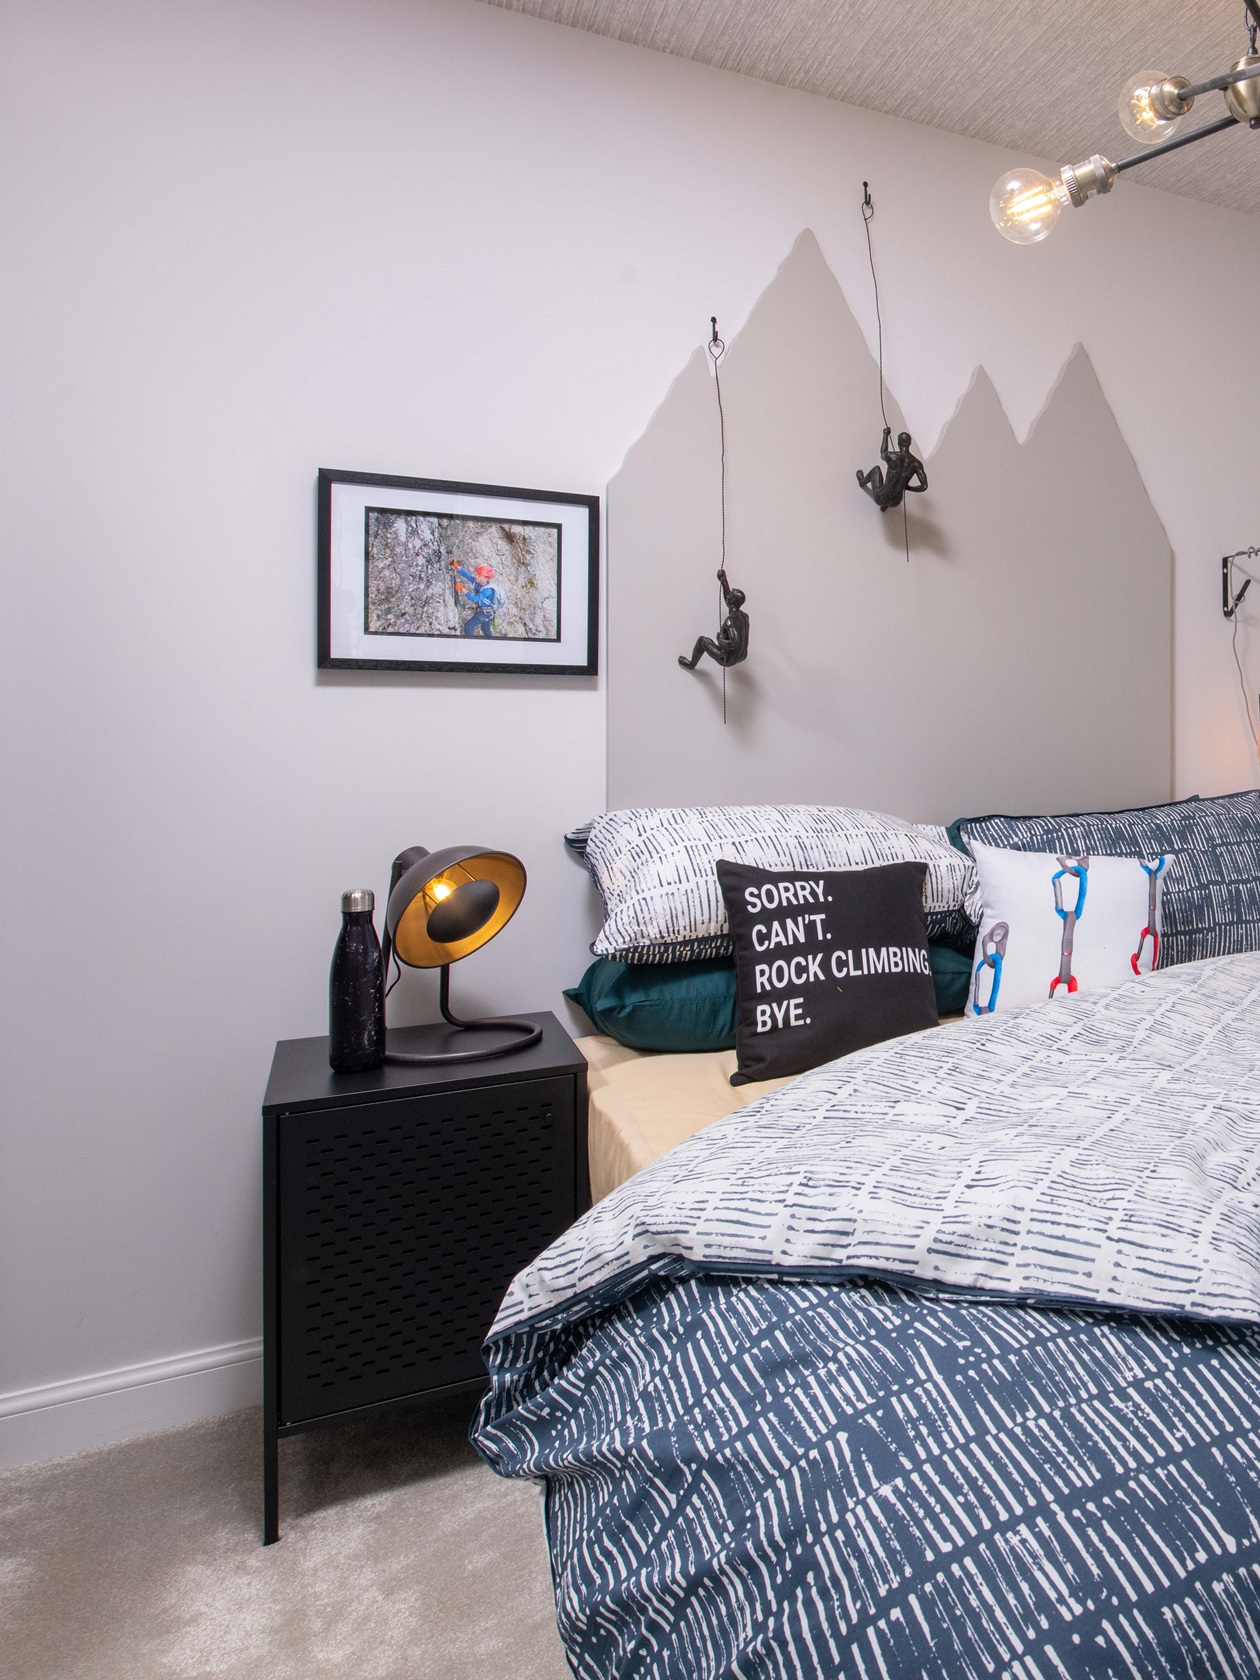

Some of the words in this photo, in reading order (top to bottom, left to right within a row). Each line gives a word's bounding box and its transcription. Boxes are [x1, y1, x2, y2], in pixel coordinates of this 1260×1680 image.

[744, 880, 833, 914] SORRY.
[751, 914, 832, 952] CAN'T.
[755, 953, 826, 993] ROCK
[756, 997, 812, 1033] BYE.
